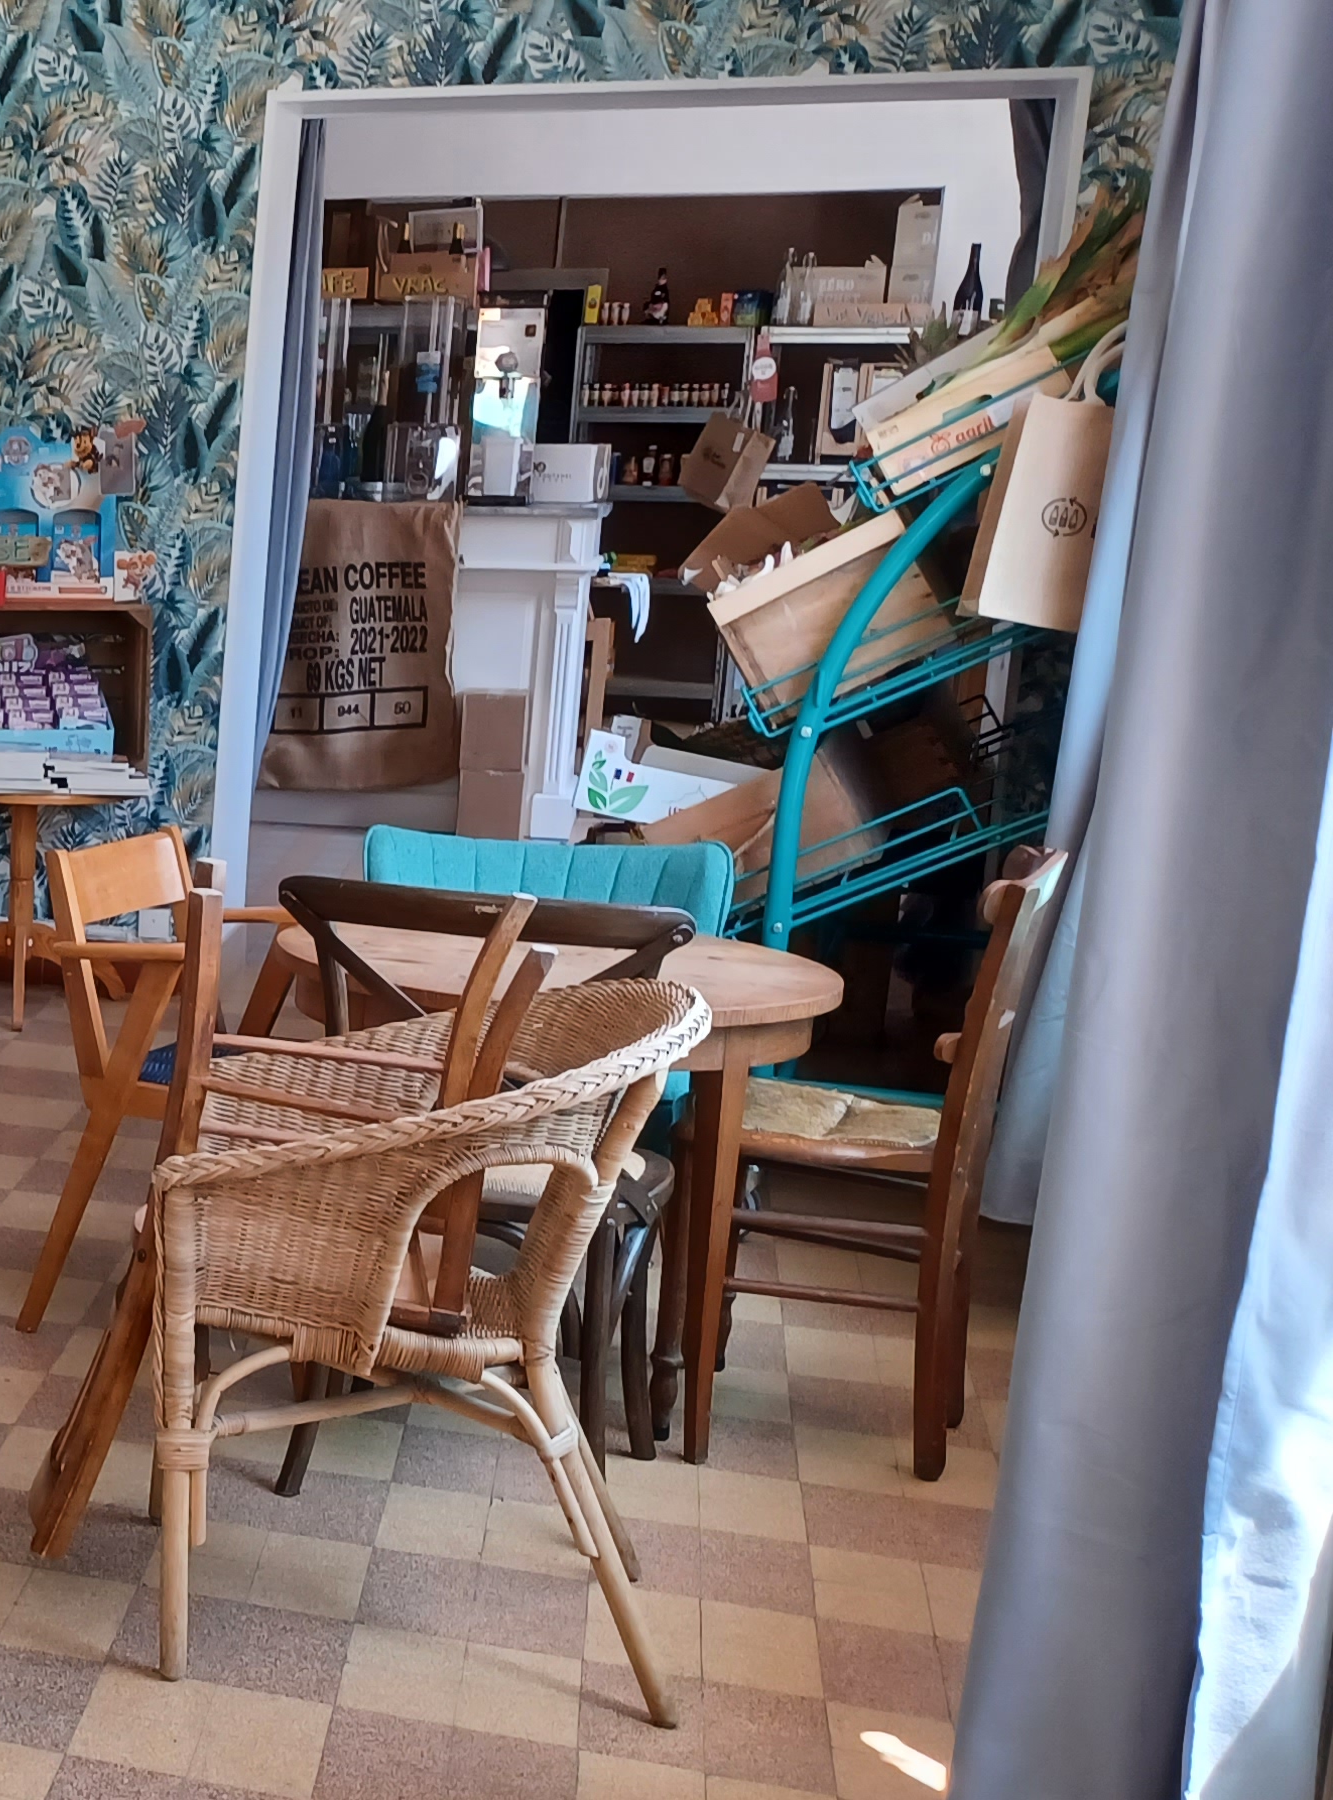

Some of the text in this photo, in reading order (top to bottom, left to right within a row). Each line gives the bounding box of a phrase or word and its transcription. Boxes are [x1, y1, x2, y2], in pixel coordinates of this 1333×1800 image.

[298, 562, 427, 595] EAN COFFEE
[349, 595, 428, 625] GUATEMALA
[350, 626, 428, 656] 2021-2022
[325, 658, 355, 692] KGS
[357, 656, 386, 689] NET
